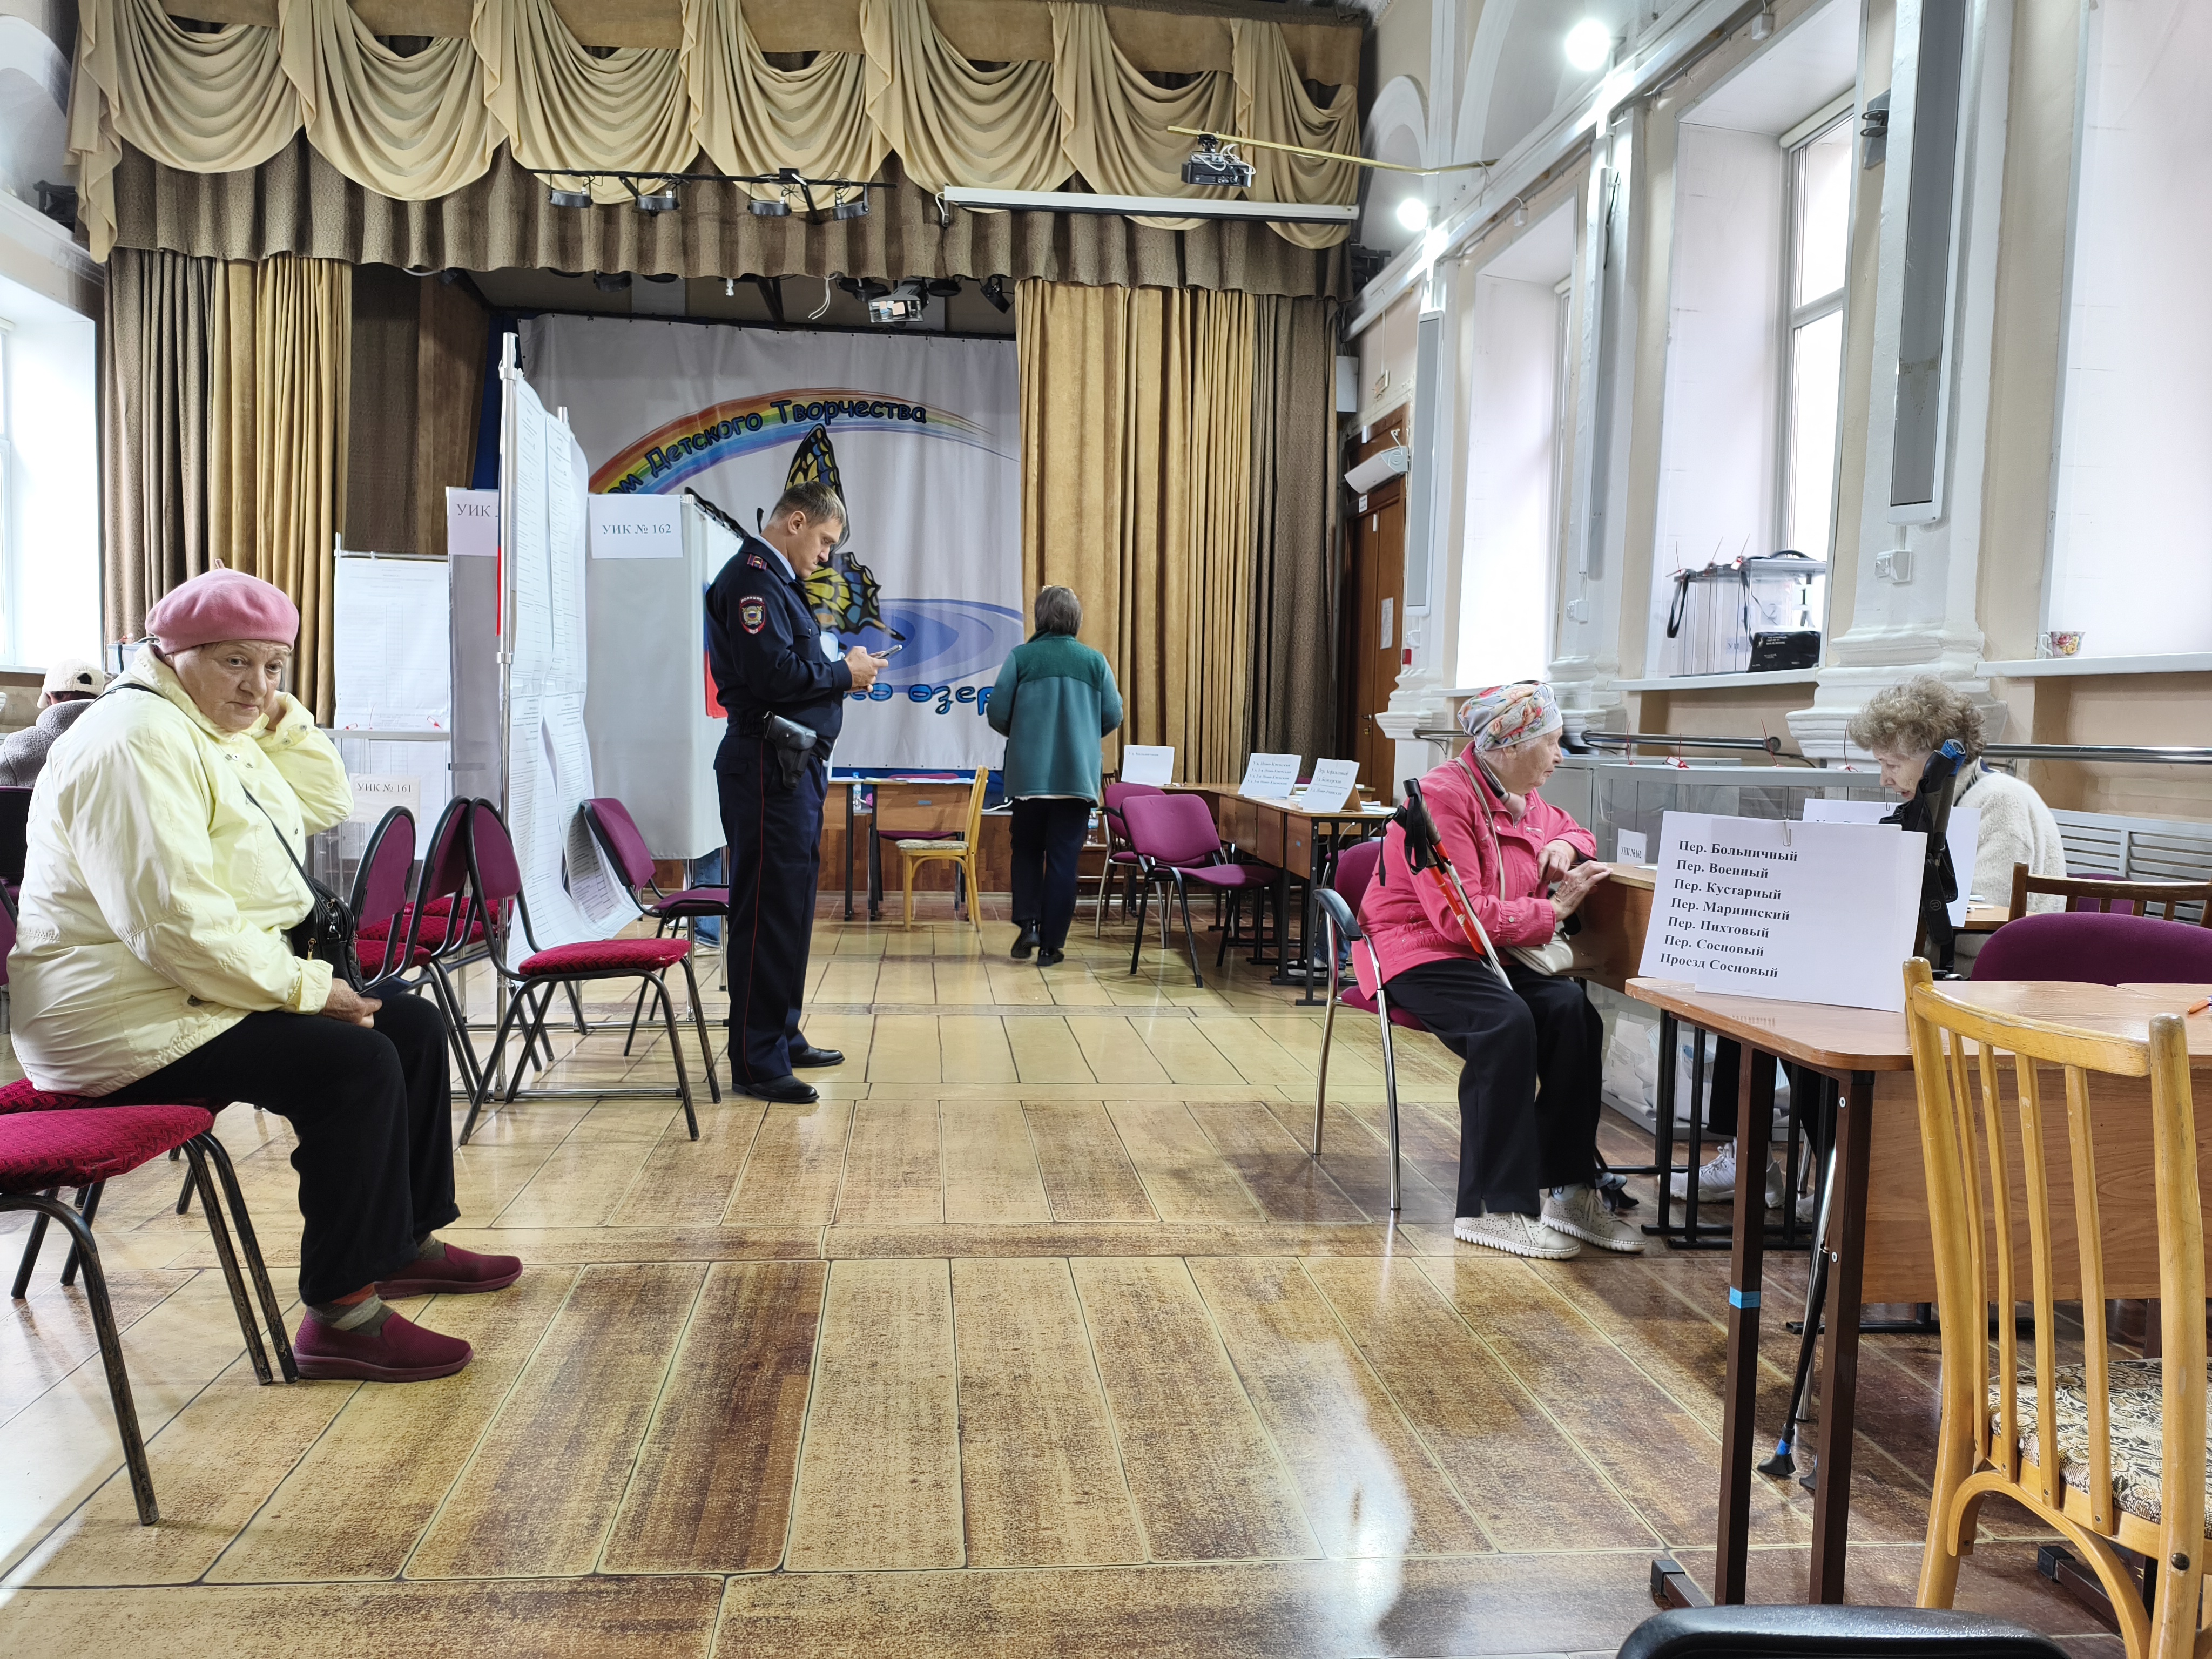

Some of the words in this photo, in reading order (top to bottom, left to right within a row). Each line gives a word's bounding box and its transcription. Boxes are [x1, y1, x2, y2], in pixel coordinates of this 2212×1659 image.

[644, 412, 763, 478] Детского
[770, 399, 927, 426] Творчества
[456, 504, 491, 517] УИК
[602, 524, 631, 534] УИК
[635, 524, 648, 534] №
[652, 524, 671, 534] 162
[909, 684, 996, 716] озер
[358, 783, 380, 792] УИК
[383, 784, 393, 792] №
[397, 784, 411, 793] 161
[1678, 840, 1707, 854] Пер.
[1710, 843, 1798, 861] Больничный
[1676, 859, 1704, 874] Пер.
[1708, 862, 1769, 879] Военный
[1673, 879, 1702, 893] Пер.
[1705, 882, 1782, 900] Кустарный
[1671, 898, 1699, 912] Пер.
[1703, 901, 1790, 921] Мариинский
[1668, 916, 1695, 930] Пер.
[1700, 920, 1769, 938] Пихтовый
[1664, 935, 1691, 949] Пер.
[1696, 939, 1764, 956] Сосновый
[1660, 953, 1705, 969] Проезд
[1709, 960, 1778, 978] Сосновый
